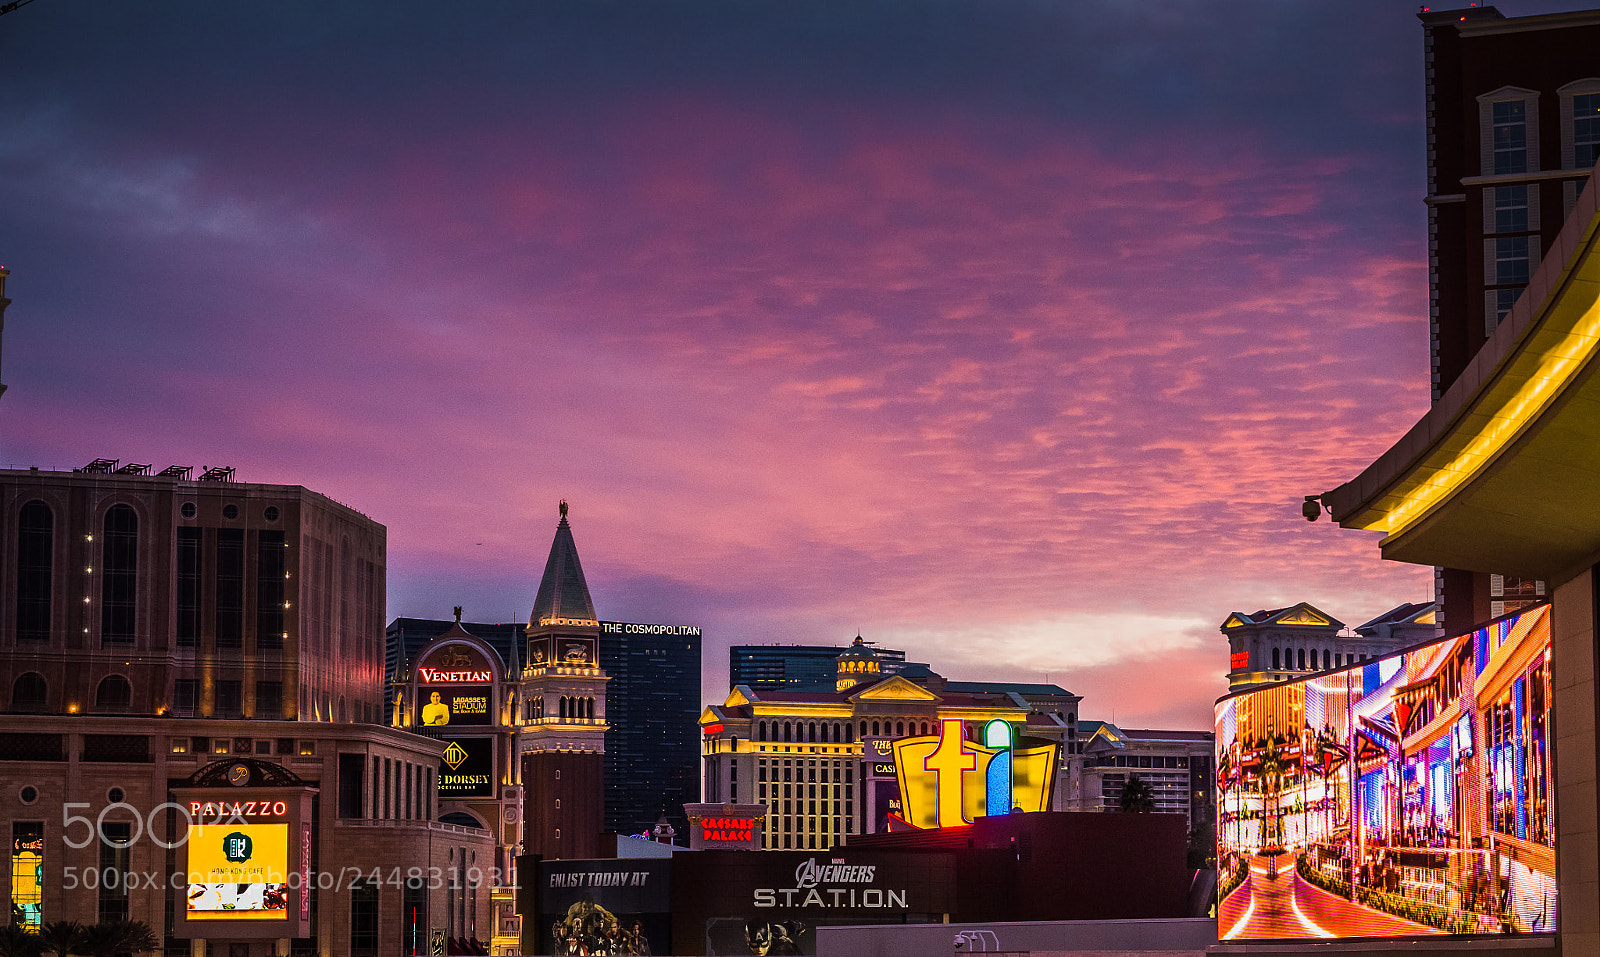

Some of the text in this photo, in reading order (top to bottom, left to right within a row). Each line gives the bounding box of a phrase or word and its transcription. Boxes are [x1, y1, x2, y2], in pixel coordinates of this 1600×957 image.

[603, 623, 700, 636] THE COSMOPOLITAN
[418, 667, 491, 683] VENETIAN
[444, 774, 490, 784] DORSEY
[190, 801, 287, 816] PALAZZO
[701, 818, 754, 829] CAESARS
[704, 830, 752, 842] PALACE
[550, 871, 650, 888] ENLIST TODAY AT
[796, 857, 876, 889] AVENGERS
